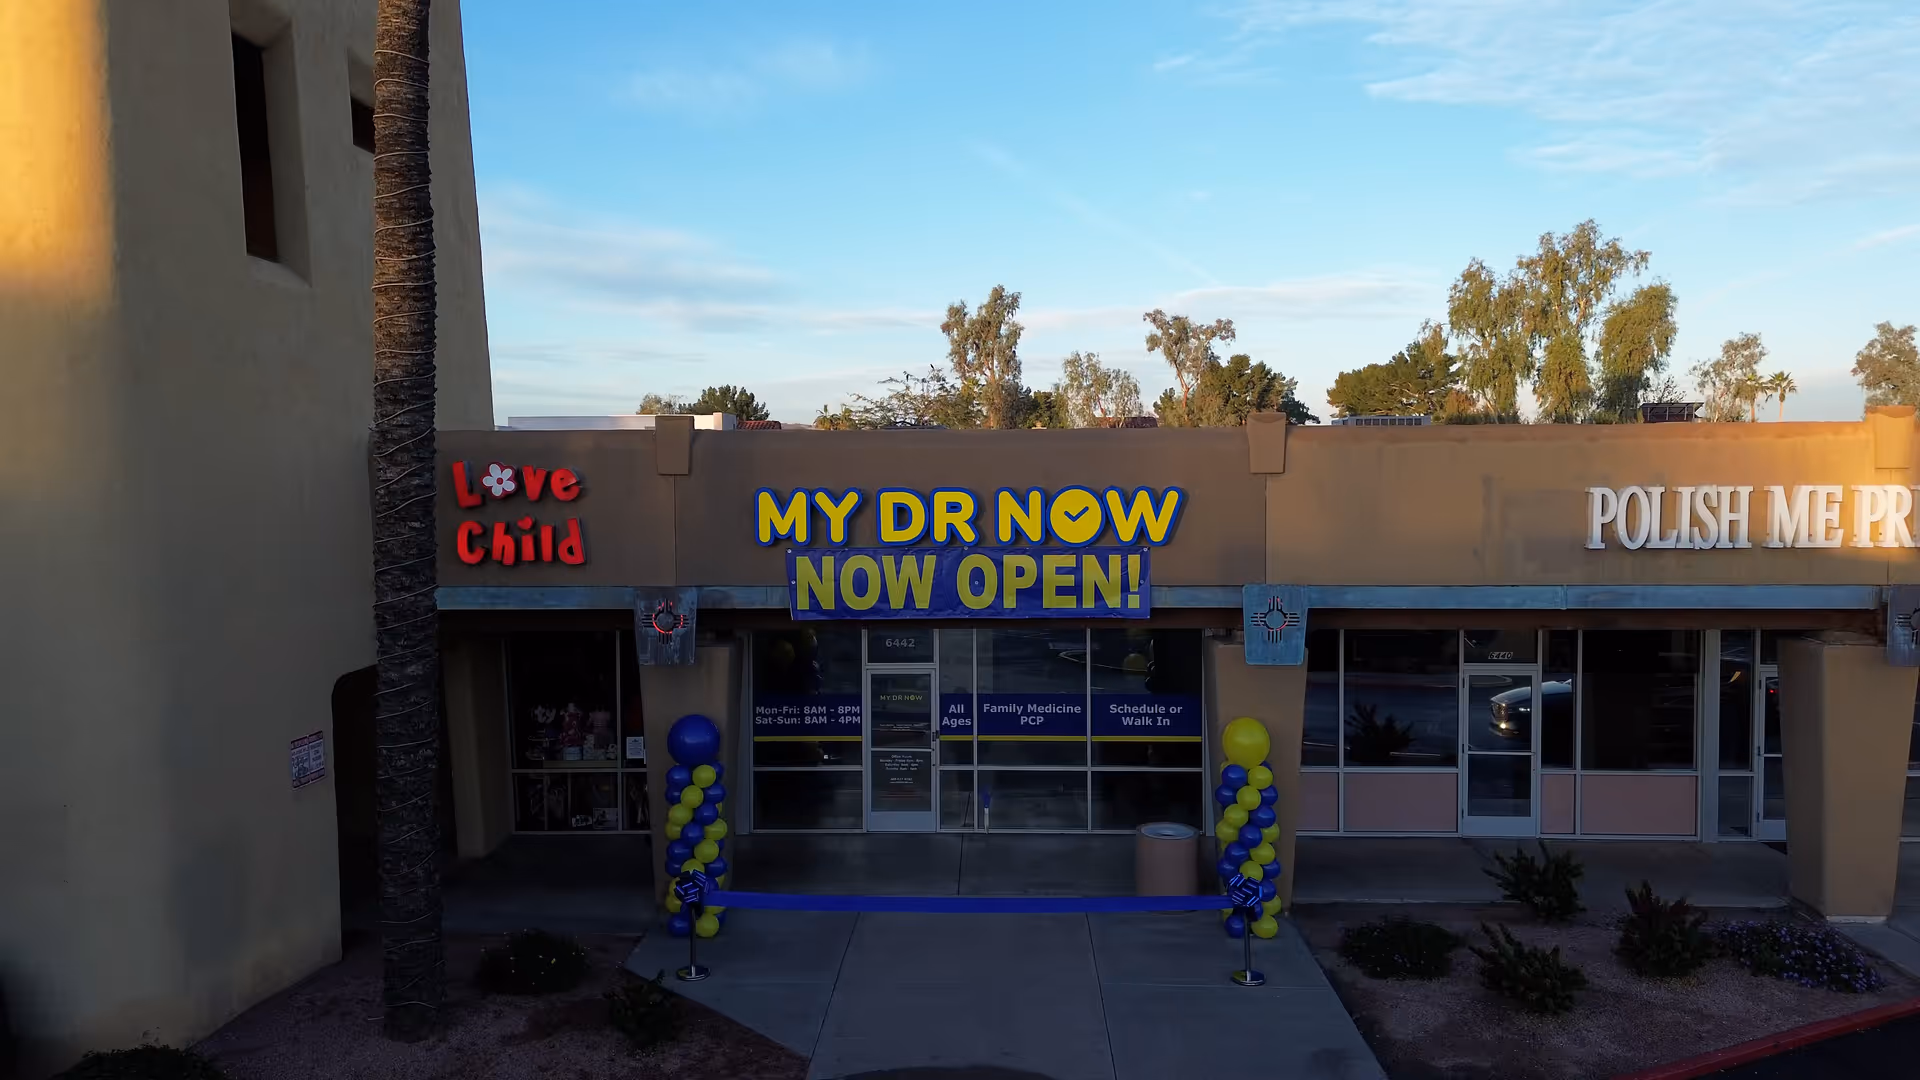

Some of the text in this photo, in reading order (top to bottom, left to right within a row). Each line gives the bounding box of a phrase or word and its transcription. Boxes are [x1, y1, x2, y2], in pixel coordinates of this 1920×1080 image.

[755, 484, 1184, 547] MY DR NOW
[1585, 485, 1754, 550] POLISH
[1762, 485, 1844, 548] ME
[456, 515, 587, 566] Child
[796, 553, 1142, 611] NOW OPEN!
[885, 638, 916, 648] 6442
[756, 706, 800, 714] Mon-Fri:
[803, 706, 827, 714] 8AM
[837, 706, 860, 714] 8PM
[948, 704, 965, 714] All
[983, 704, 1082, 715] Family Medicine
[1109, 704, 1183, 714] Schedule or
[755, 716, 801, 724] Sat-Sun:
[804, 716, 827, 724] 8AM
[838, 716, 861, 724] 4PM
[941, 716, 972, 728] Ages
[1020, 716, 1044, 726] PCP
[1121, 716, 1171, 727] Walk In
